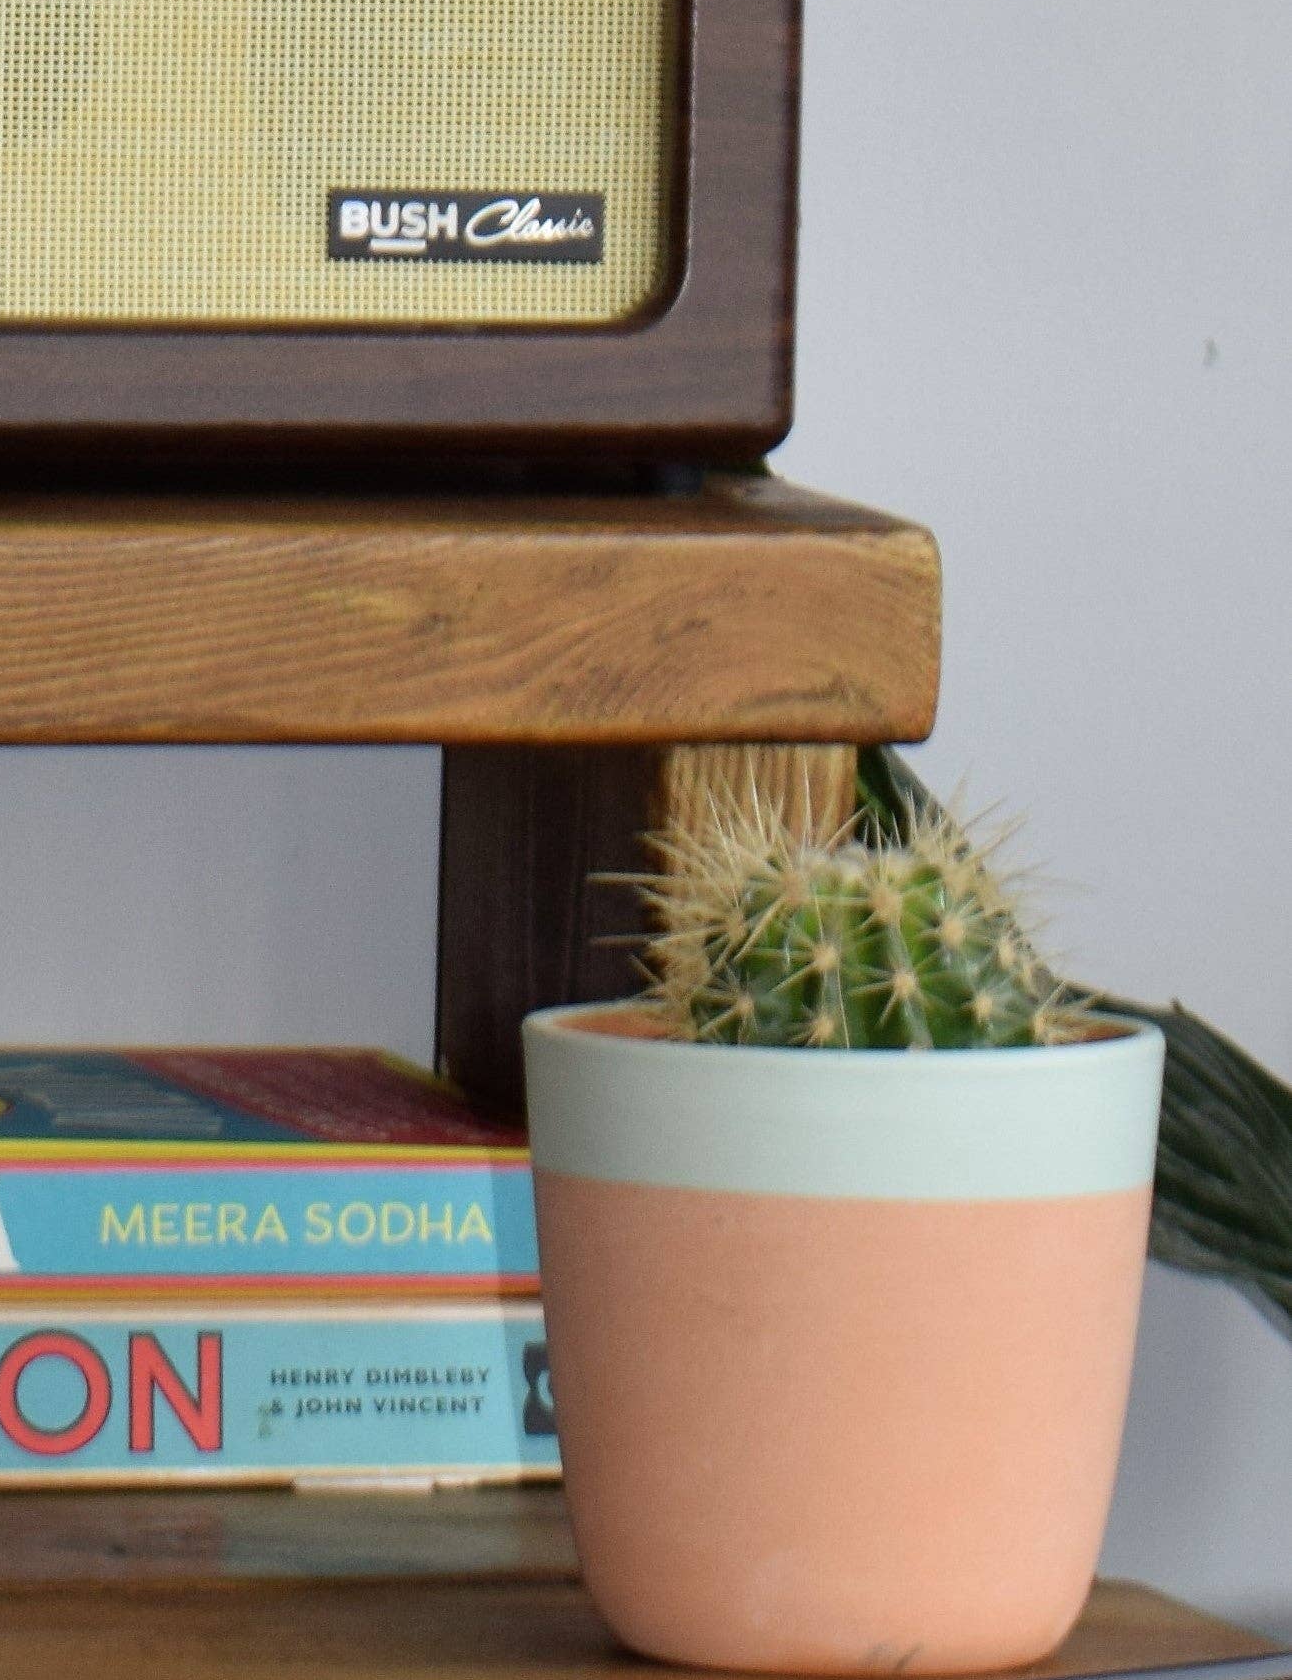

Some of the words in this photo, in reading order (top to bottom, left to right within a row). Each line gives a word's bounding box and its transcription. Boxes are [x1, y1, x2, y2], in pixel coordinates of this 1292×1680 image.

[339, 199, 458, 239] BUSH
[466, 196, 594, 246] Classic
[100, 1202, 289, 1245] MEERA
[304, 1202, 493, 1243] SODHA
[271, 1367, 354, 1385] HENRY
[366, 1367, 490, 1385] DIMBLEBY
[296, 1396, 363, 1418] JOHN
[374, 1396, 484, 1414] VINCENT
